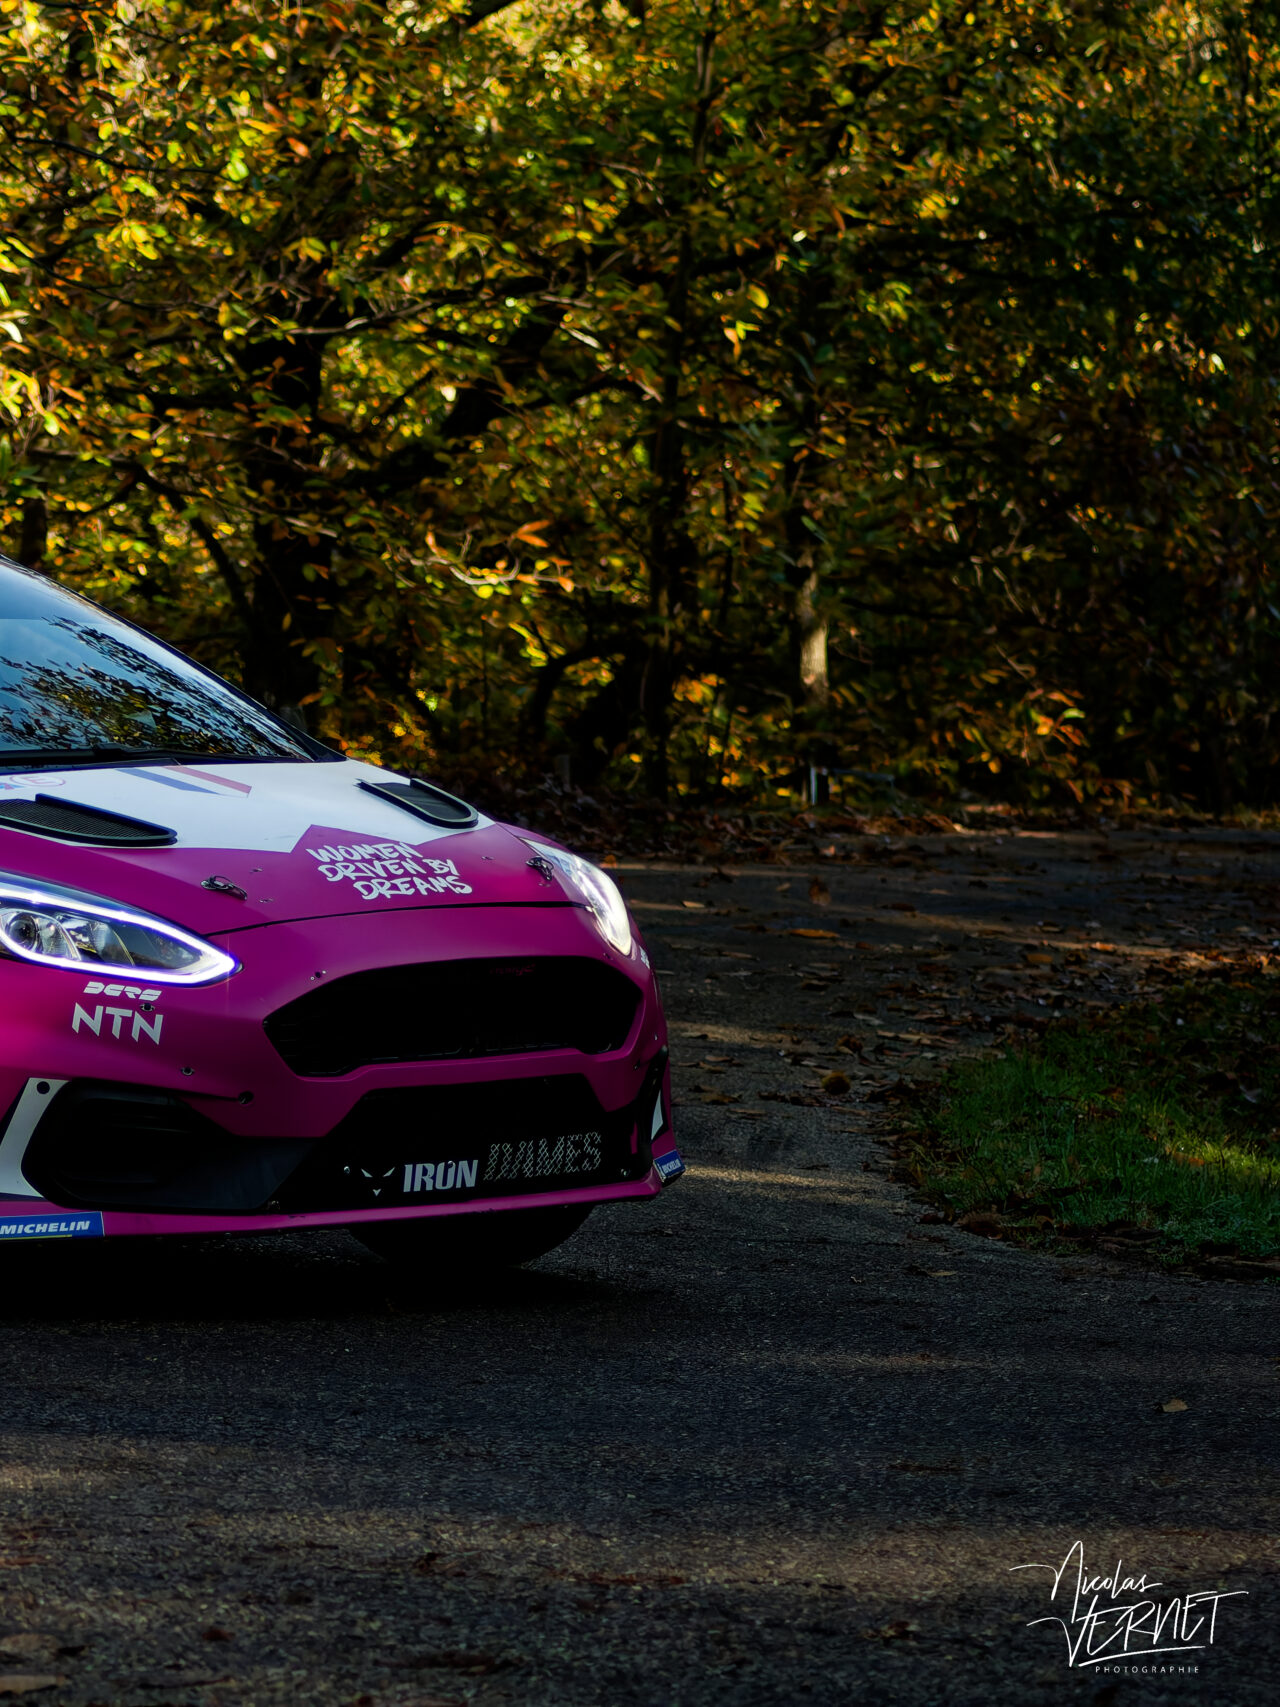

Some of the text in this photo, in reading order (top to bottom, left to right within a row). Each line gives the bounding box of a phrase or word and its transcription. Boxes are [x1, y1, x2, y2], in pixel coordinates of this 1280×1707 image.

[305, 841, 424, 863] WOMEN
[317, 858, 461, 882] DRIVEN BY
[353, 875, 473, 900] DREAMS
[71, 1002, 164, 1045] NTN
[402, 1130, 603, 1193] IRON DAMES
[0, 1220, 91, 1235] MICHELIN
